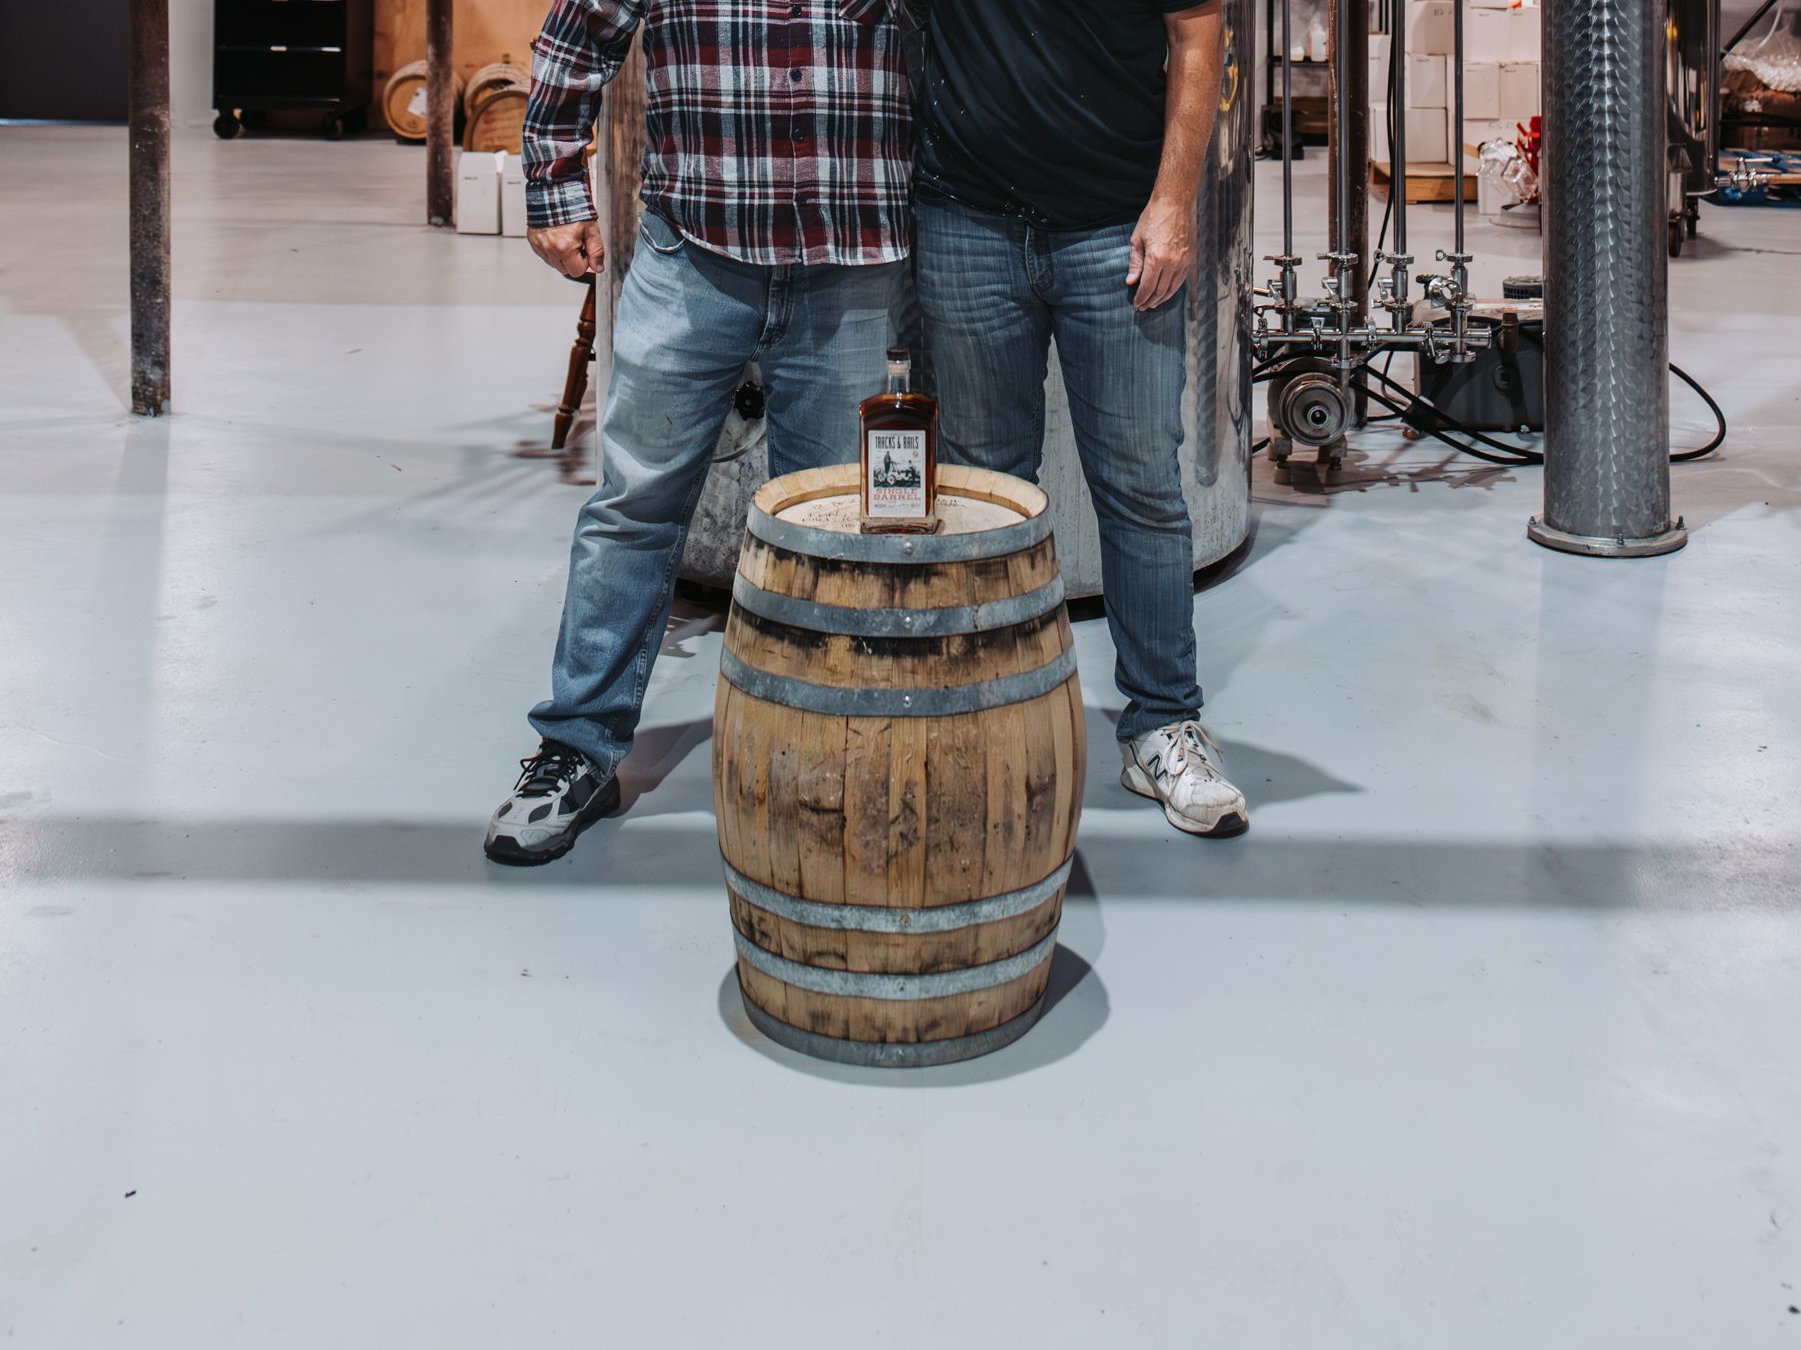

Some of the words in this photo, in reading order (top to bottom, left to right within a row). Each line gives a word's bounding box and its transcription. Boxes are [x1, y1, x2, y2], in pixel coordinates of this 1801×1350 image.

[875, 436, 896, 450] TRACKS
[897, 436, 902, 450] &
[903, 436, 919, 450] RAILS
